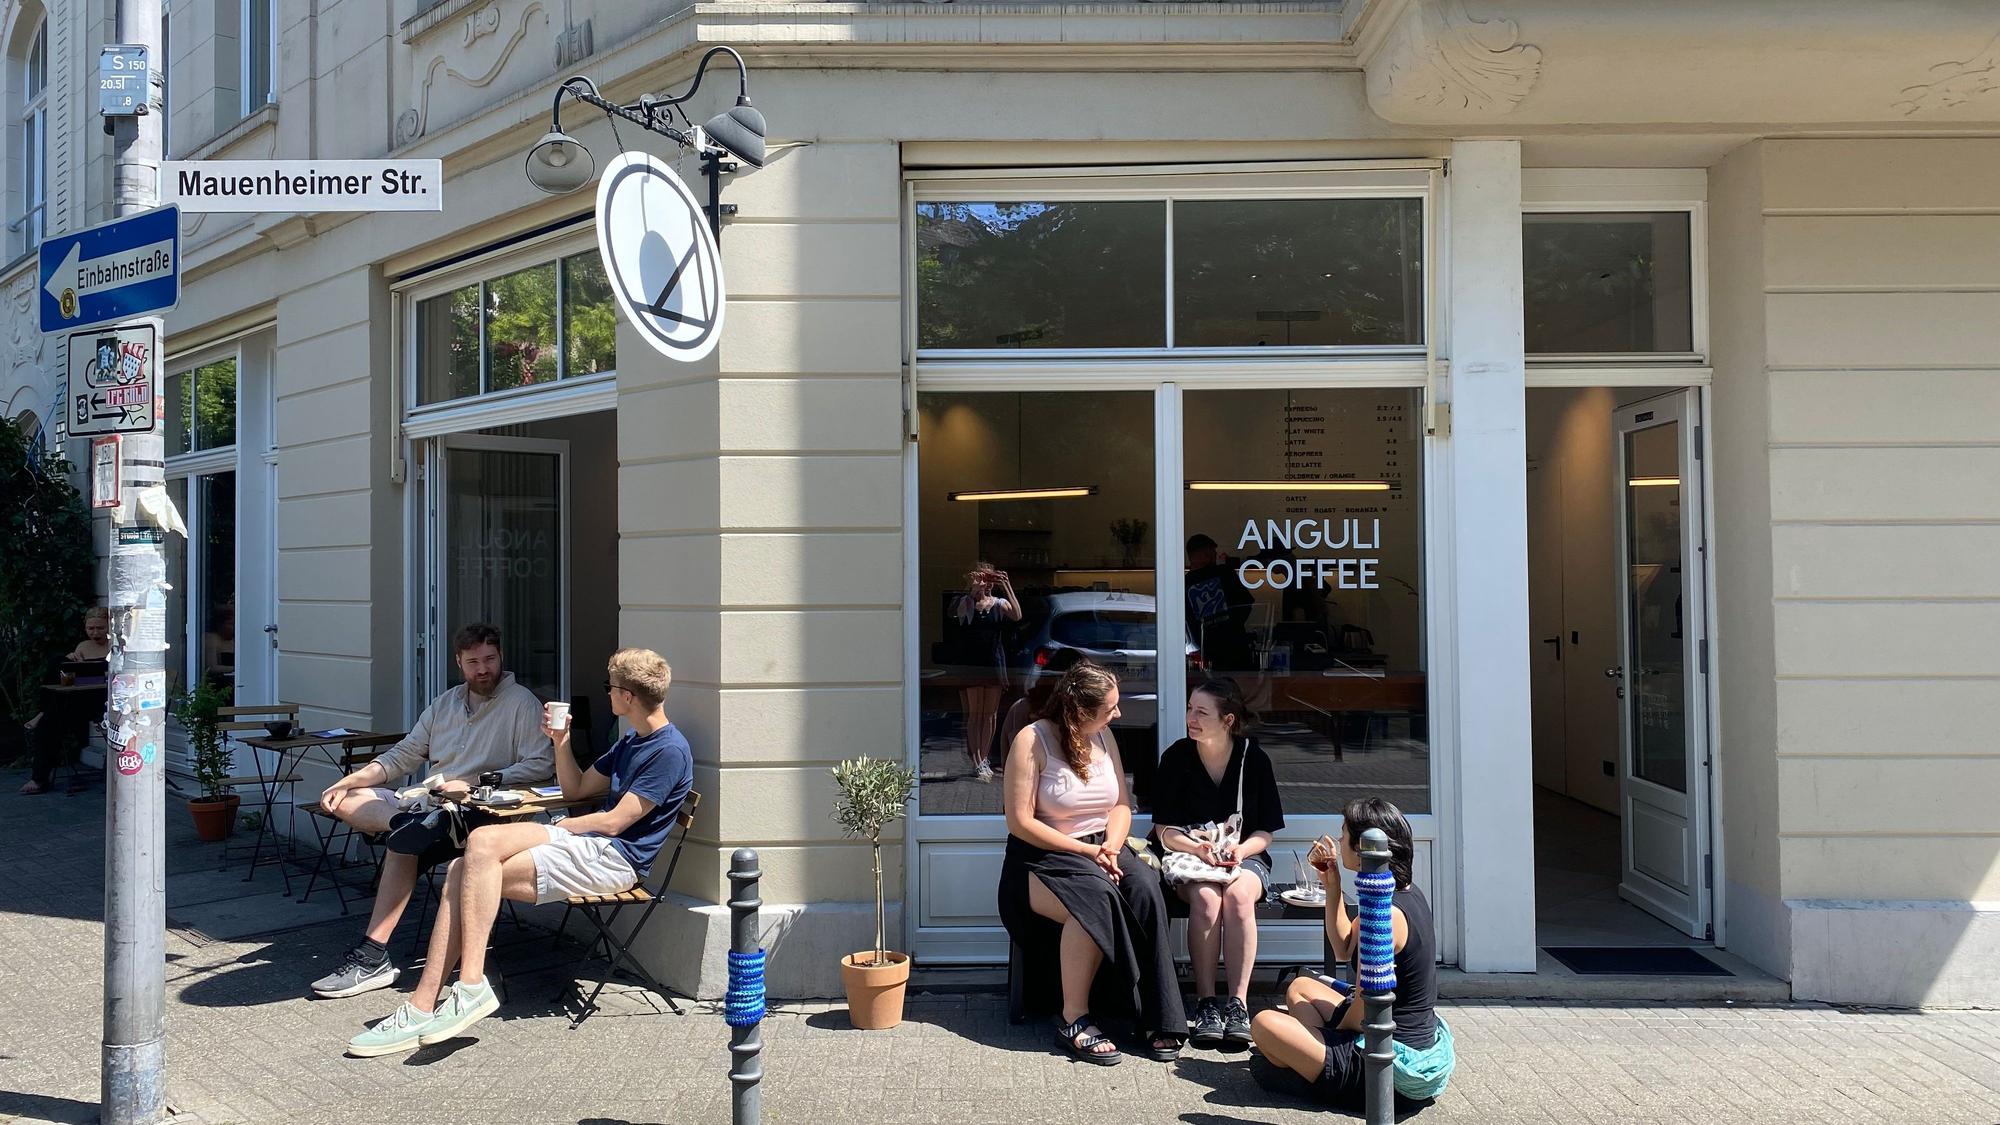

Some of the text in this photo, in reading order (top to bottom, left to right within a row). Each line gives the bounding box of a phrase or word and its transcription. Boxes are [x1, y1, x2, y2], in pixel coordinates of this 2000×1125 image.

[112, 55, 146, 70] S 150
[178, 168, 427, 197] Mauenheimer Str.
[77, 250, 171, 290] Einbahnstraße
[1237, 518, 1380, 550] ANGULI
[1237, 558, 1380, 590] COFFEE
